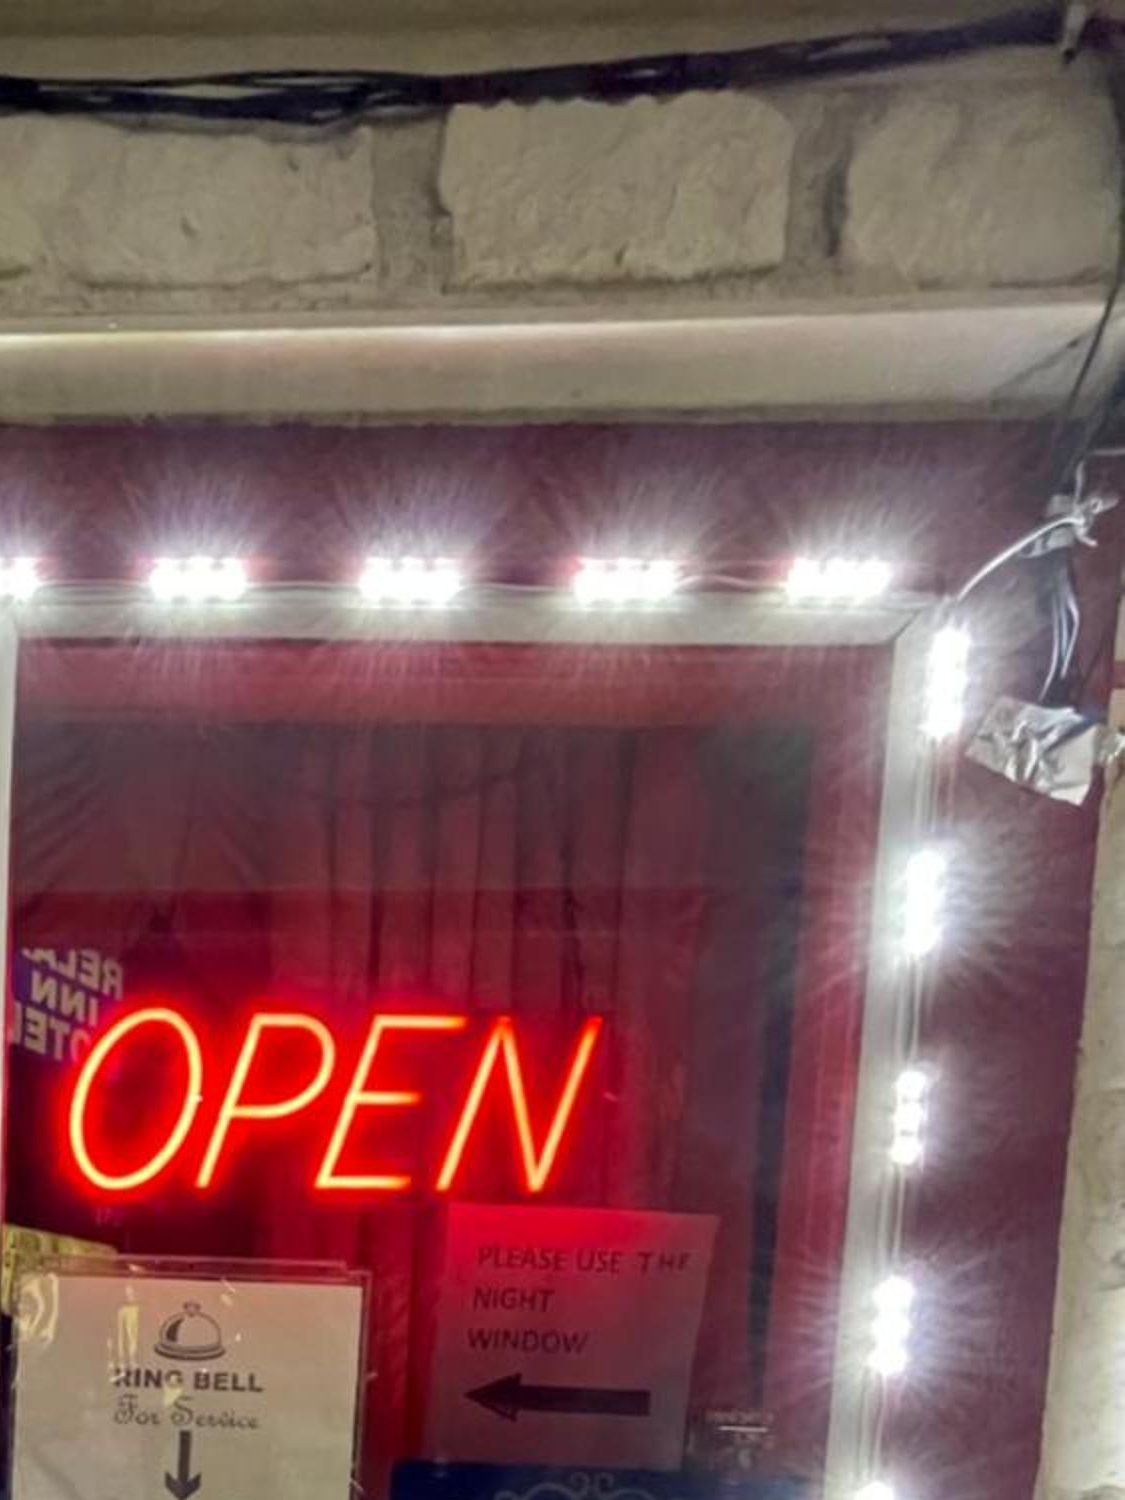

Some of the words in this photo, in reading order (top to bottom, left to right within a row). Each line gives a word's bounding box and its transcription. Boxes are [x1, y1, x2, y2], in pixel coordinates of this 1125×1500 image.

[68, 1005, 604, 1194] OPEN
[477, 1244, 567, 1272] PLEASE
[576, 1249, 623, 1274] USE
[472, 1286, 556, 1313] NIGHT
[466, 1327, 590, 1354] WINDOW
[113, 1367, 184, 1389] RING
[193, 1370, 264, 1393] BELL
[113, 1393, 161, 1426] For
[170, 1395, 260, 1429] Service
